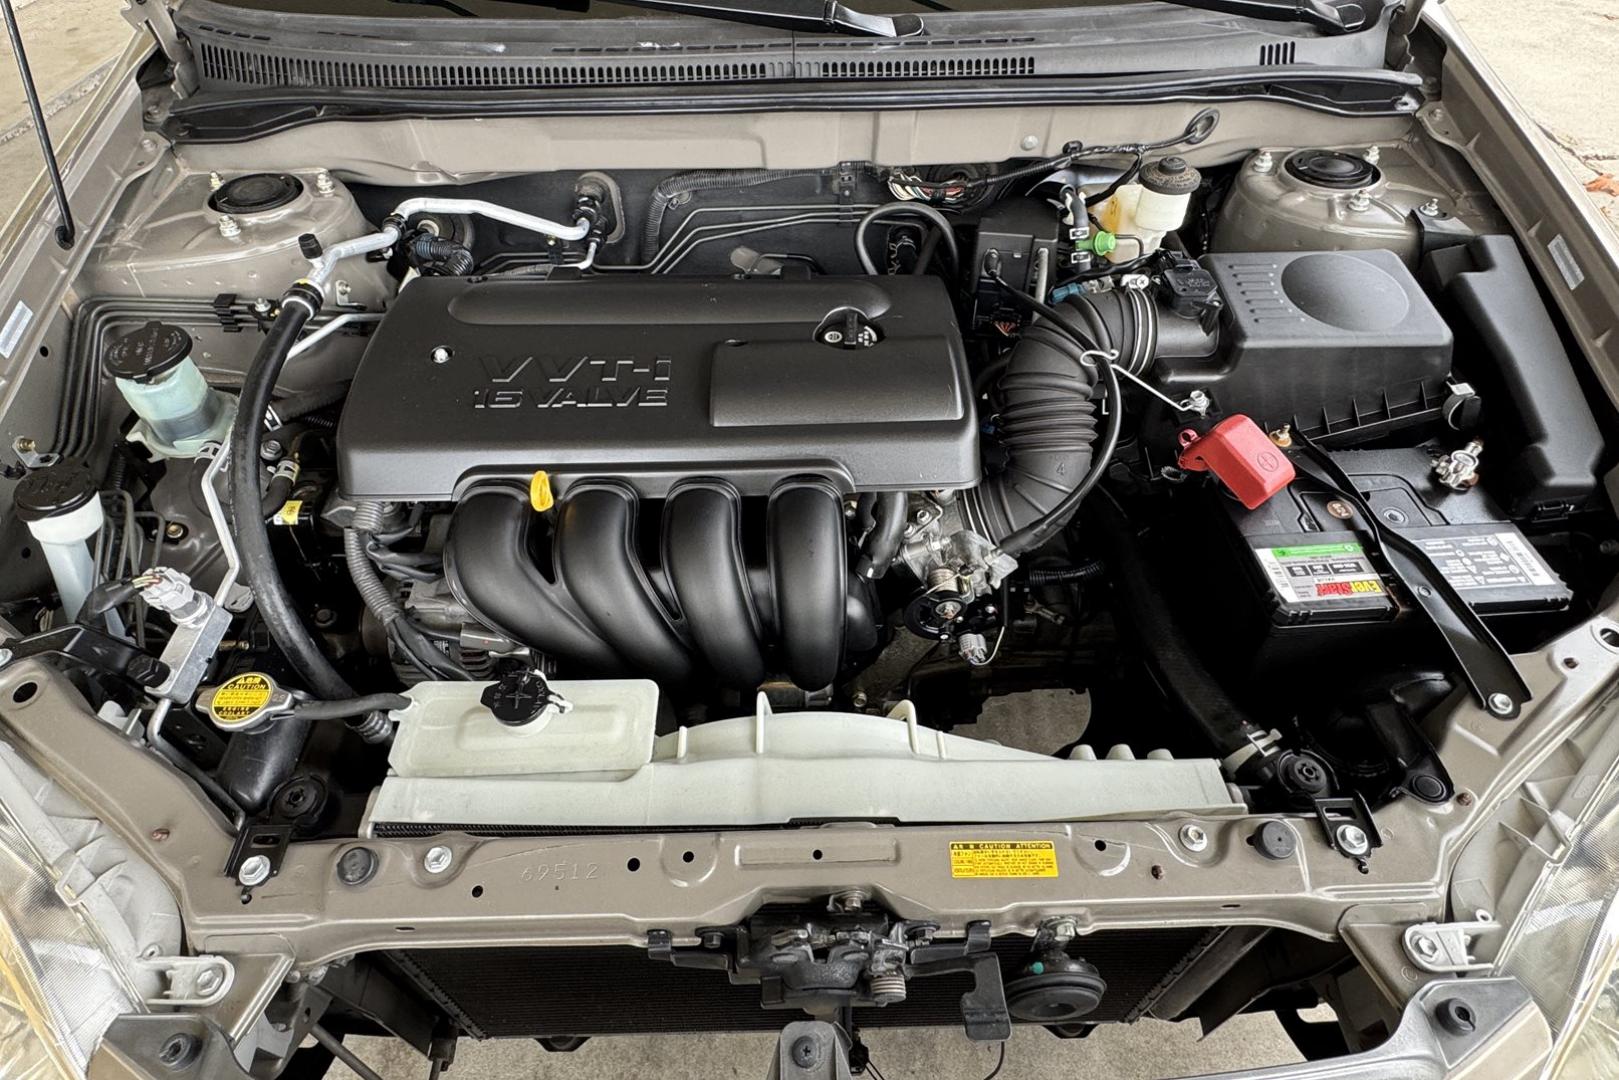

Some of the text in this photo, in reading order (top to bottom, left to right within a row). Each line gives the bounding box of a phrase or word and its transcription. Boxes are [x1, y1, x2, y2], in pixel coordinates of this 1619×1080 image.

[474, 386, 668, 408] 16 VALVE
[1315, 580, 1383, 596] EverStart
[1015, 842, 1052, 850] ATTENTION
[520, 862, 599, 881] 69512
